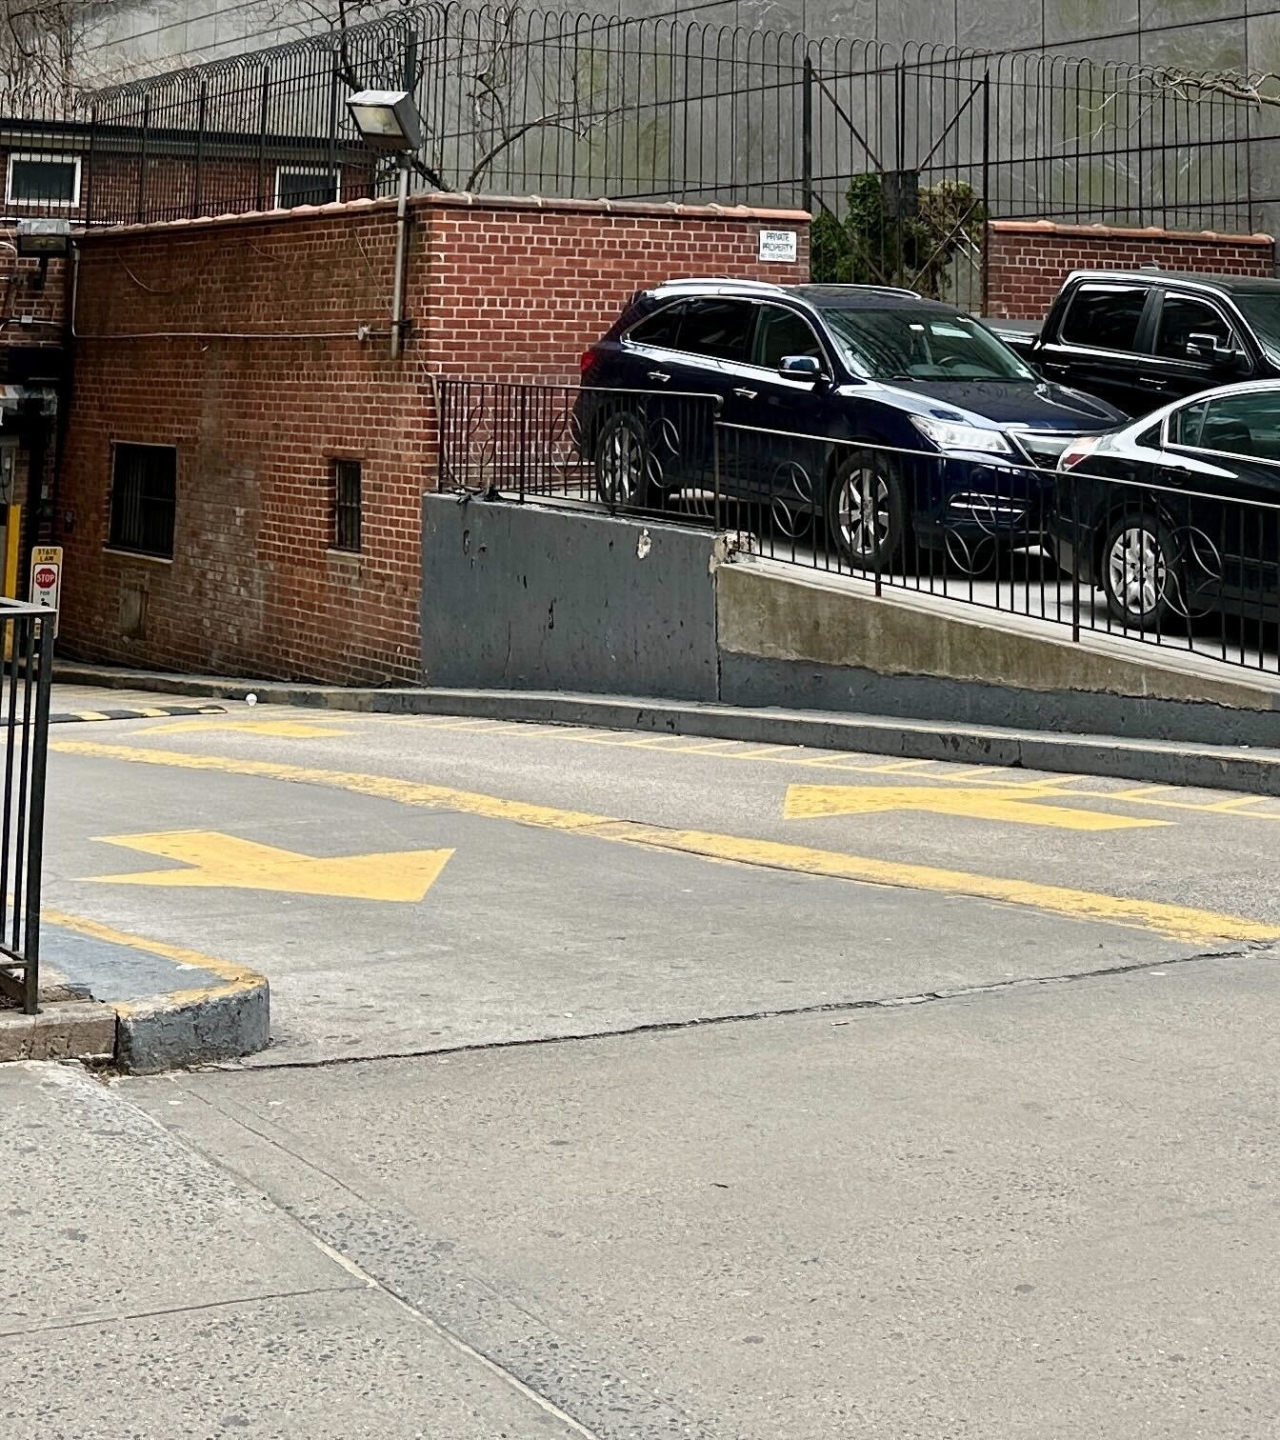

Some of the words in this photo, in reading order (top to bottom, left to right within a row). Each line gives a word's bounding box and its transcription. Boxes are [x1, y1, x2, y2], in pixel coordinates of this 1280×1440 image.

[766, 232, 790, 242] PRIVATE
[762, 242, 794, 252] PROPERTY
[37, 548, 58, 556] STATE
[36, 573, 55, 583] STOP
